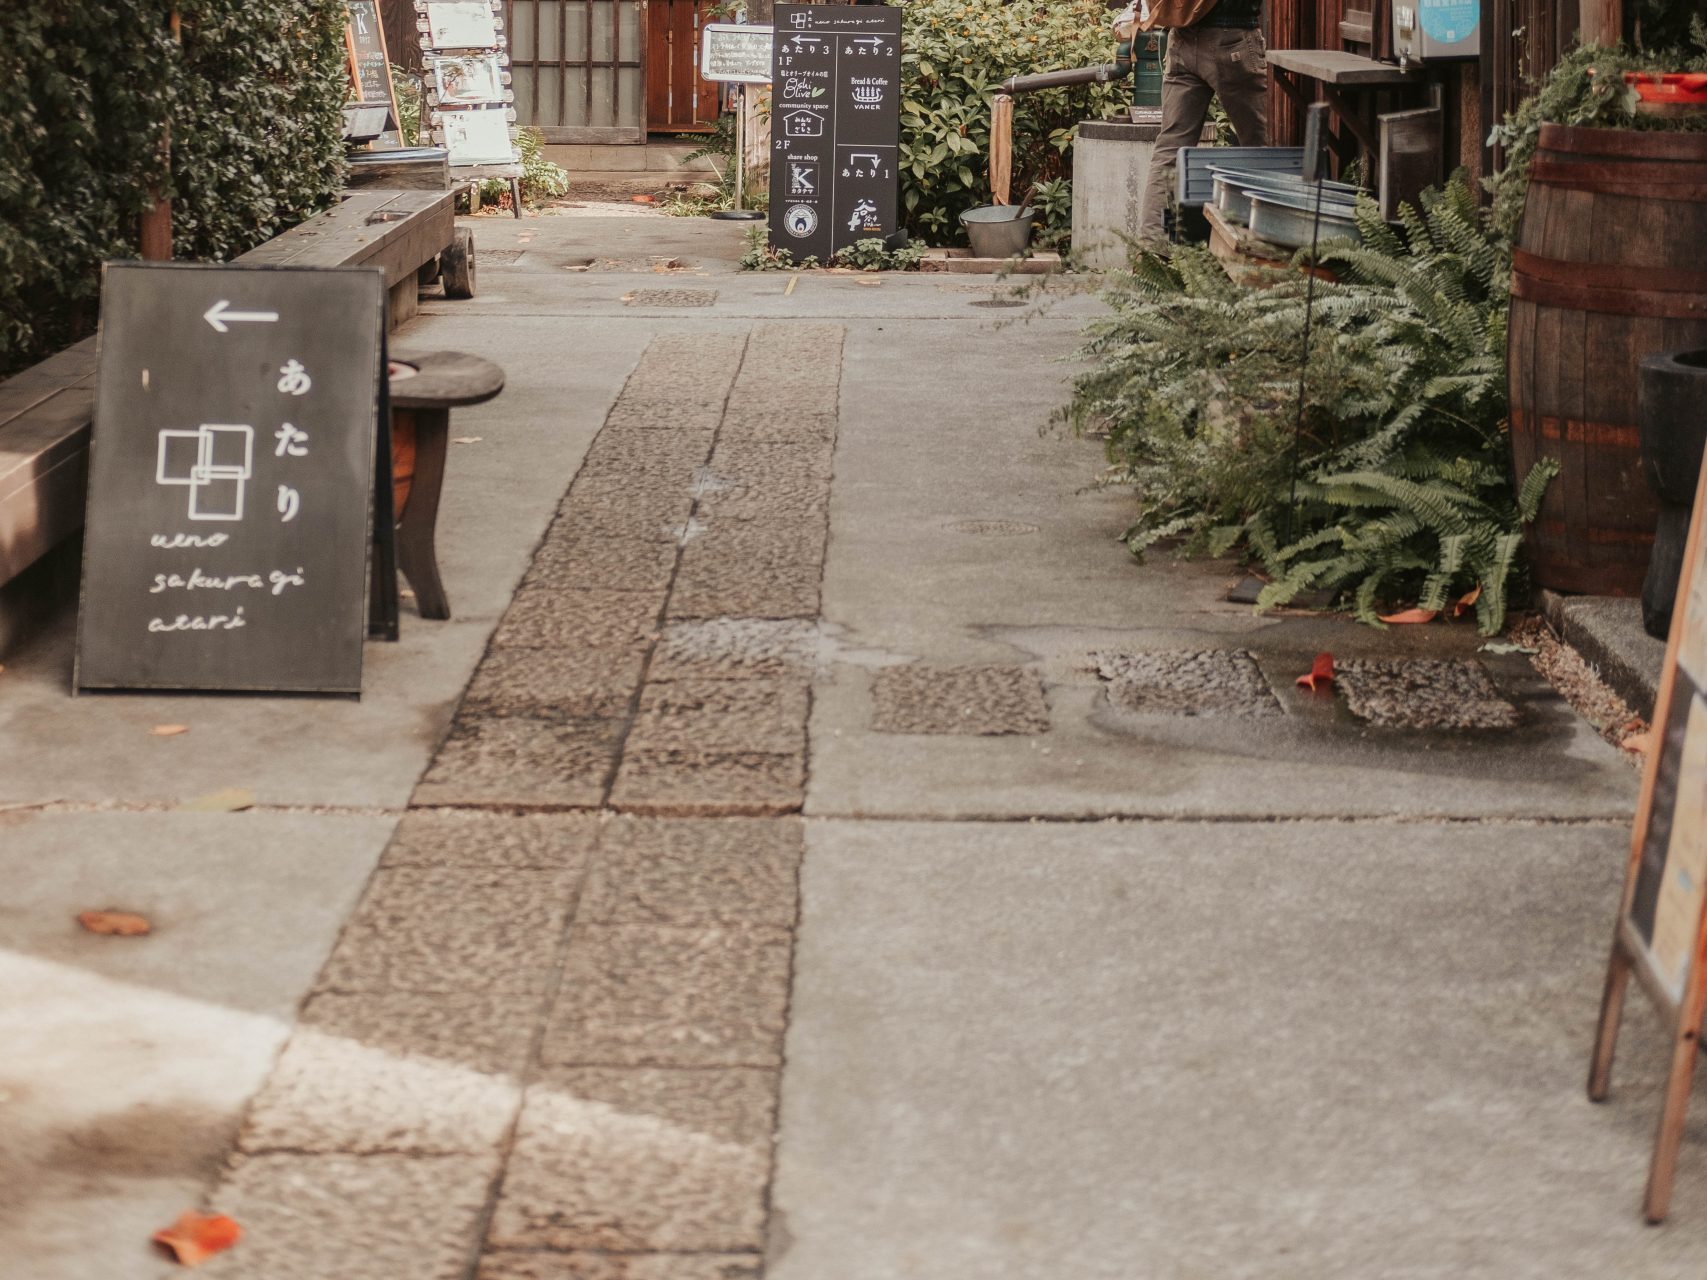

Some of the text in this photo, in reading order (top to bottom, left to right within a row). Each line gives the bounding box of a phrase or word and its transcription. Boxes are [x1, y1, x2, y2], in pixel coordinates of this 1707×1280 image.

[785, 77, 812, 91] Oshi
[851, 76, 866, 85] Bread
[871, 77, 889, 86] Coffee
[783, 86, 811, 99] Olive
[778, 102, 812, 110] community
[803, 153, 819, 162] shop
[274, 358, 312, 523] あたり
[150, 531, 230, 549] ueno
[148, 606, 247, 633] atari
